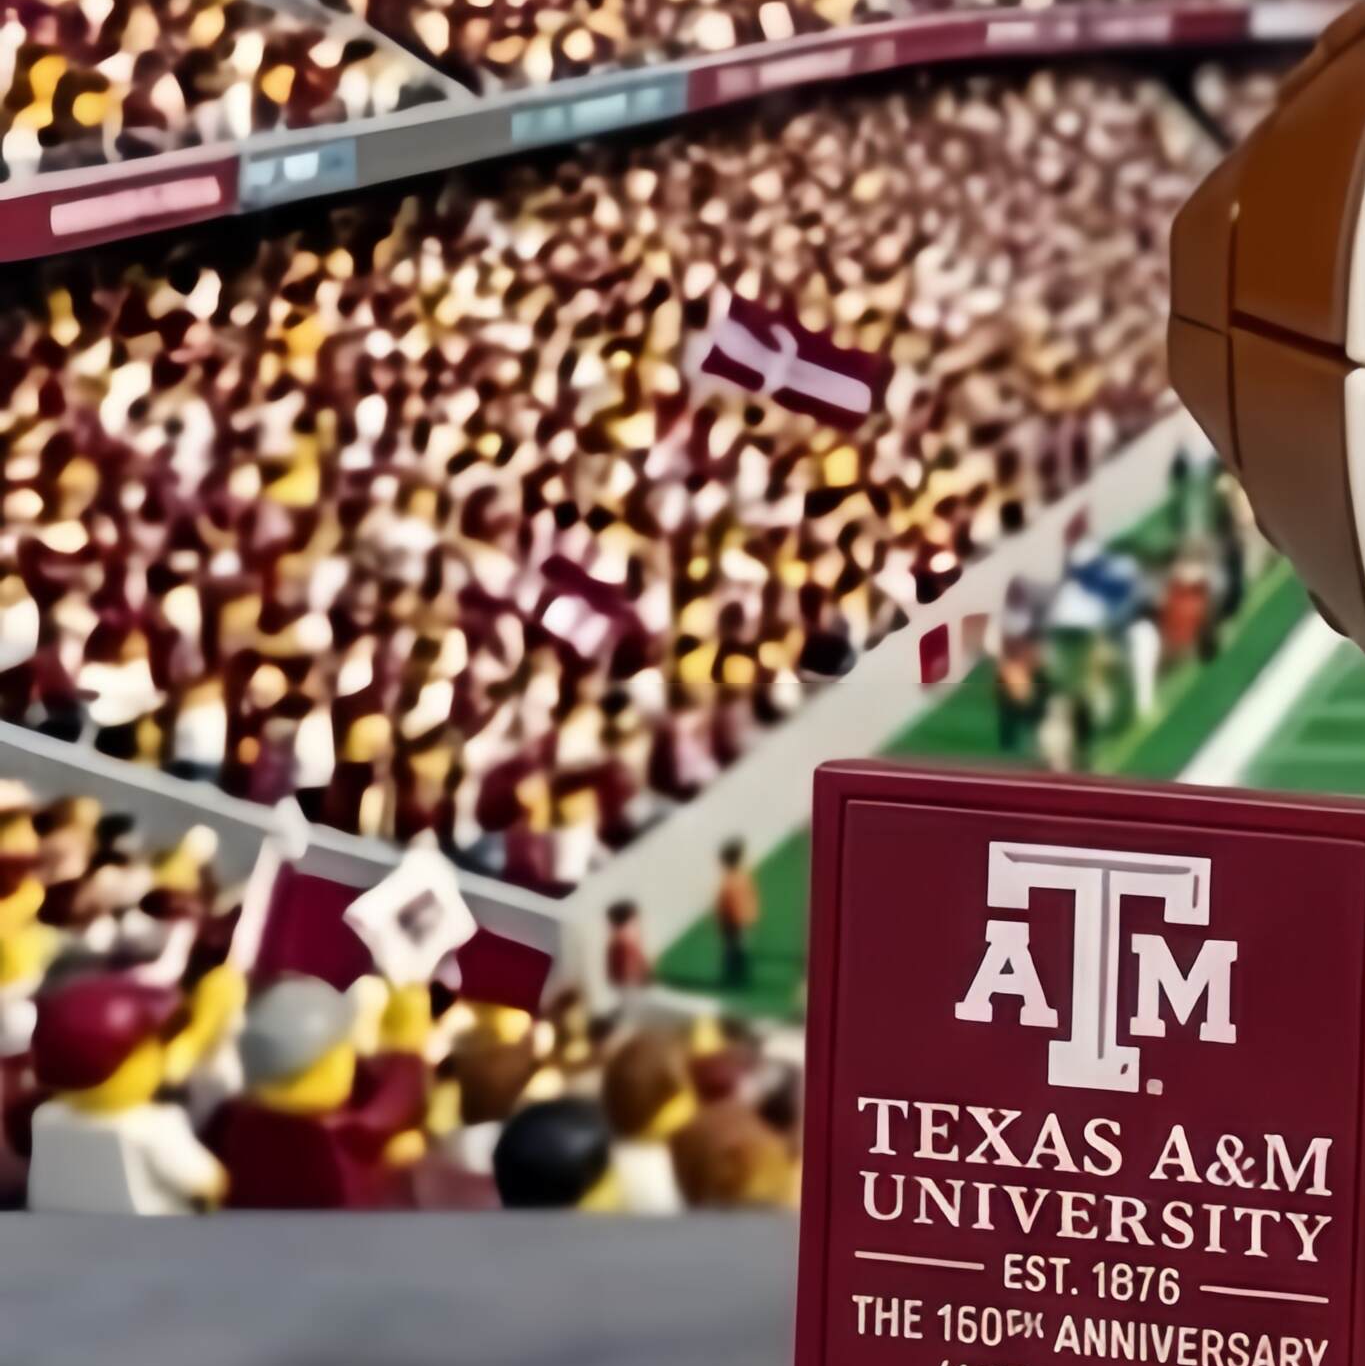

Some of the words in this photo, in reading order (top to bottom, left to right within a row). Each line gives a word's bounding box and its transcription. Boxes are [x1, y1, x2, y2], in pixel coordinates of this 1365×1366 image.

[857, 1096, 1123, 1177] TEXAS
[1149, 1123, 1333, 1197] A&M
[859, 1170, 1333, 1263] UNIVERSITY
[1003, 1253, 1079, 1296] EST.
[1092, 1261, 1181, 1305] 1876
[851, 1294, 923, 1339] THE
